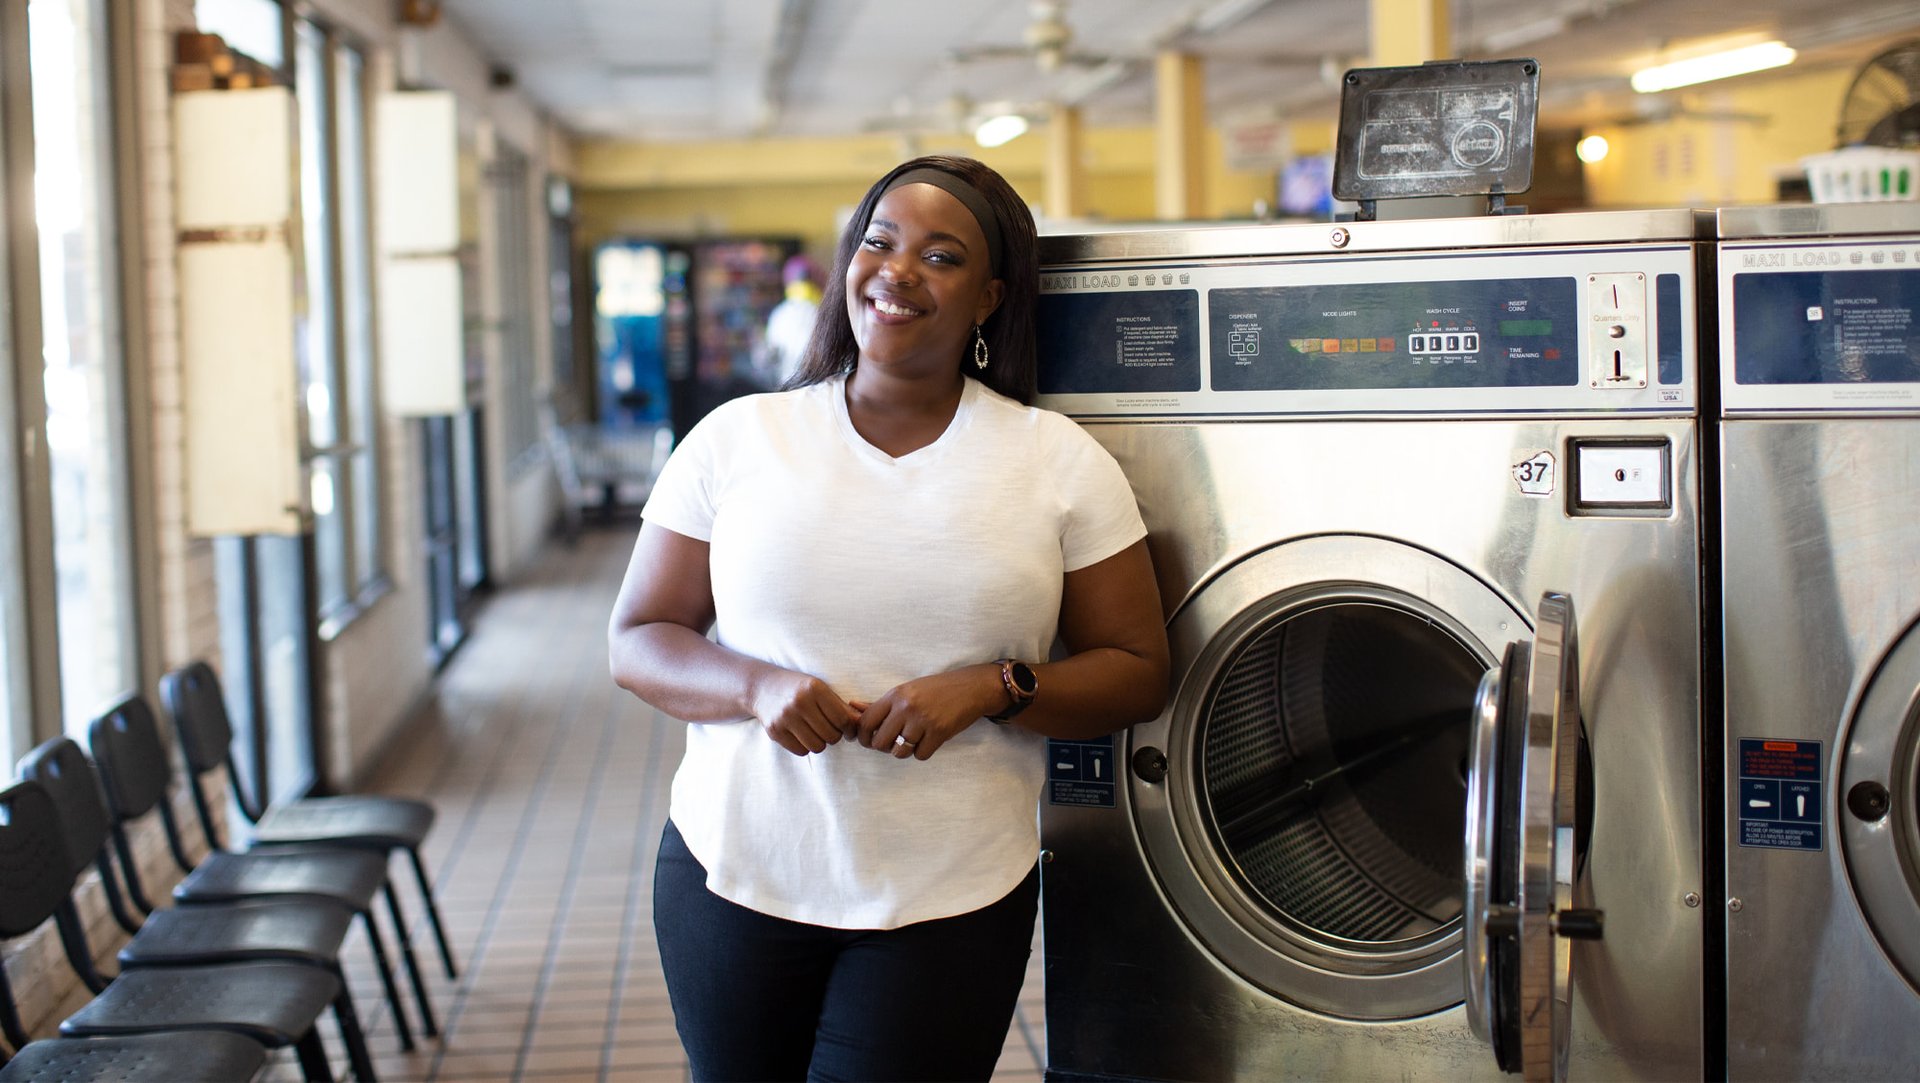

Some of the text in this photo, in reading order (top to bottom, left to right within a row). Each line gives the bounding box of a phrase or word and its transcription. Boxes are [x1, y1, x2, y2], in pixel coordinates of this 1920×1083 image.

[1742, 252, 1841, 268] MAXI LOAD
[1041, 274, 1121, 290] MAXI LOAD
[1519, 462, 1548, 483] 37
